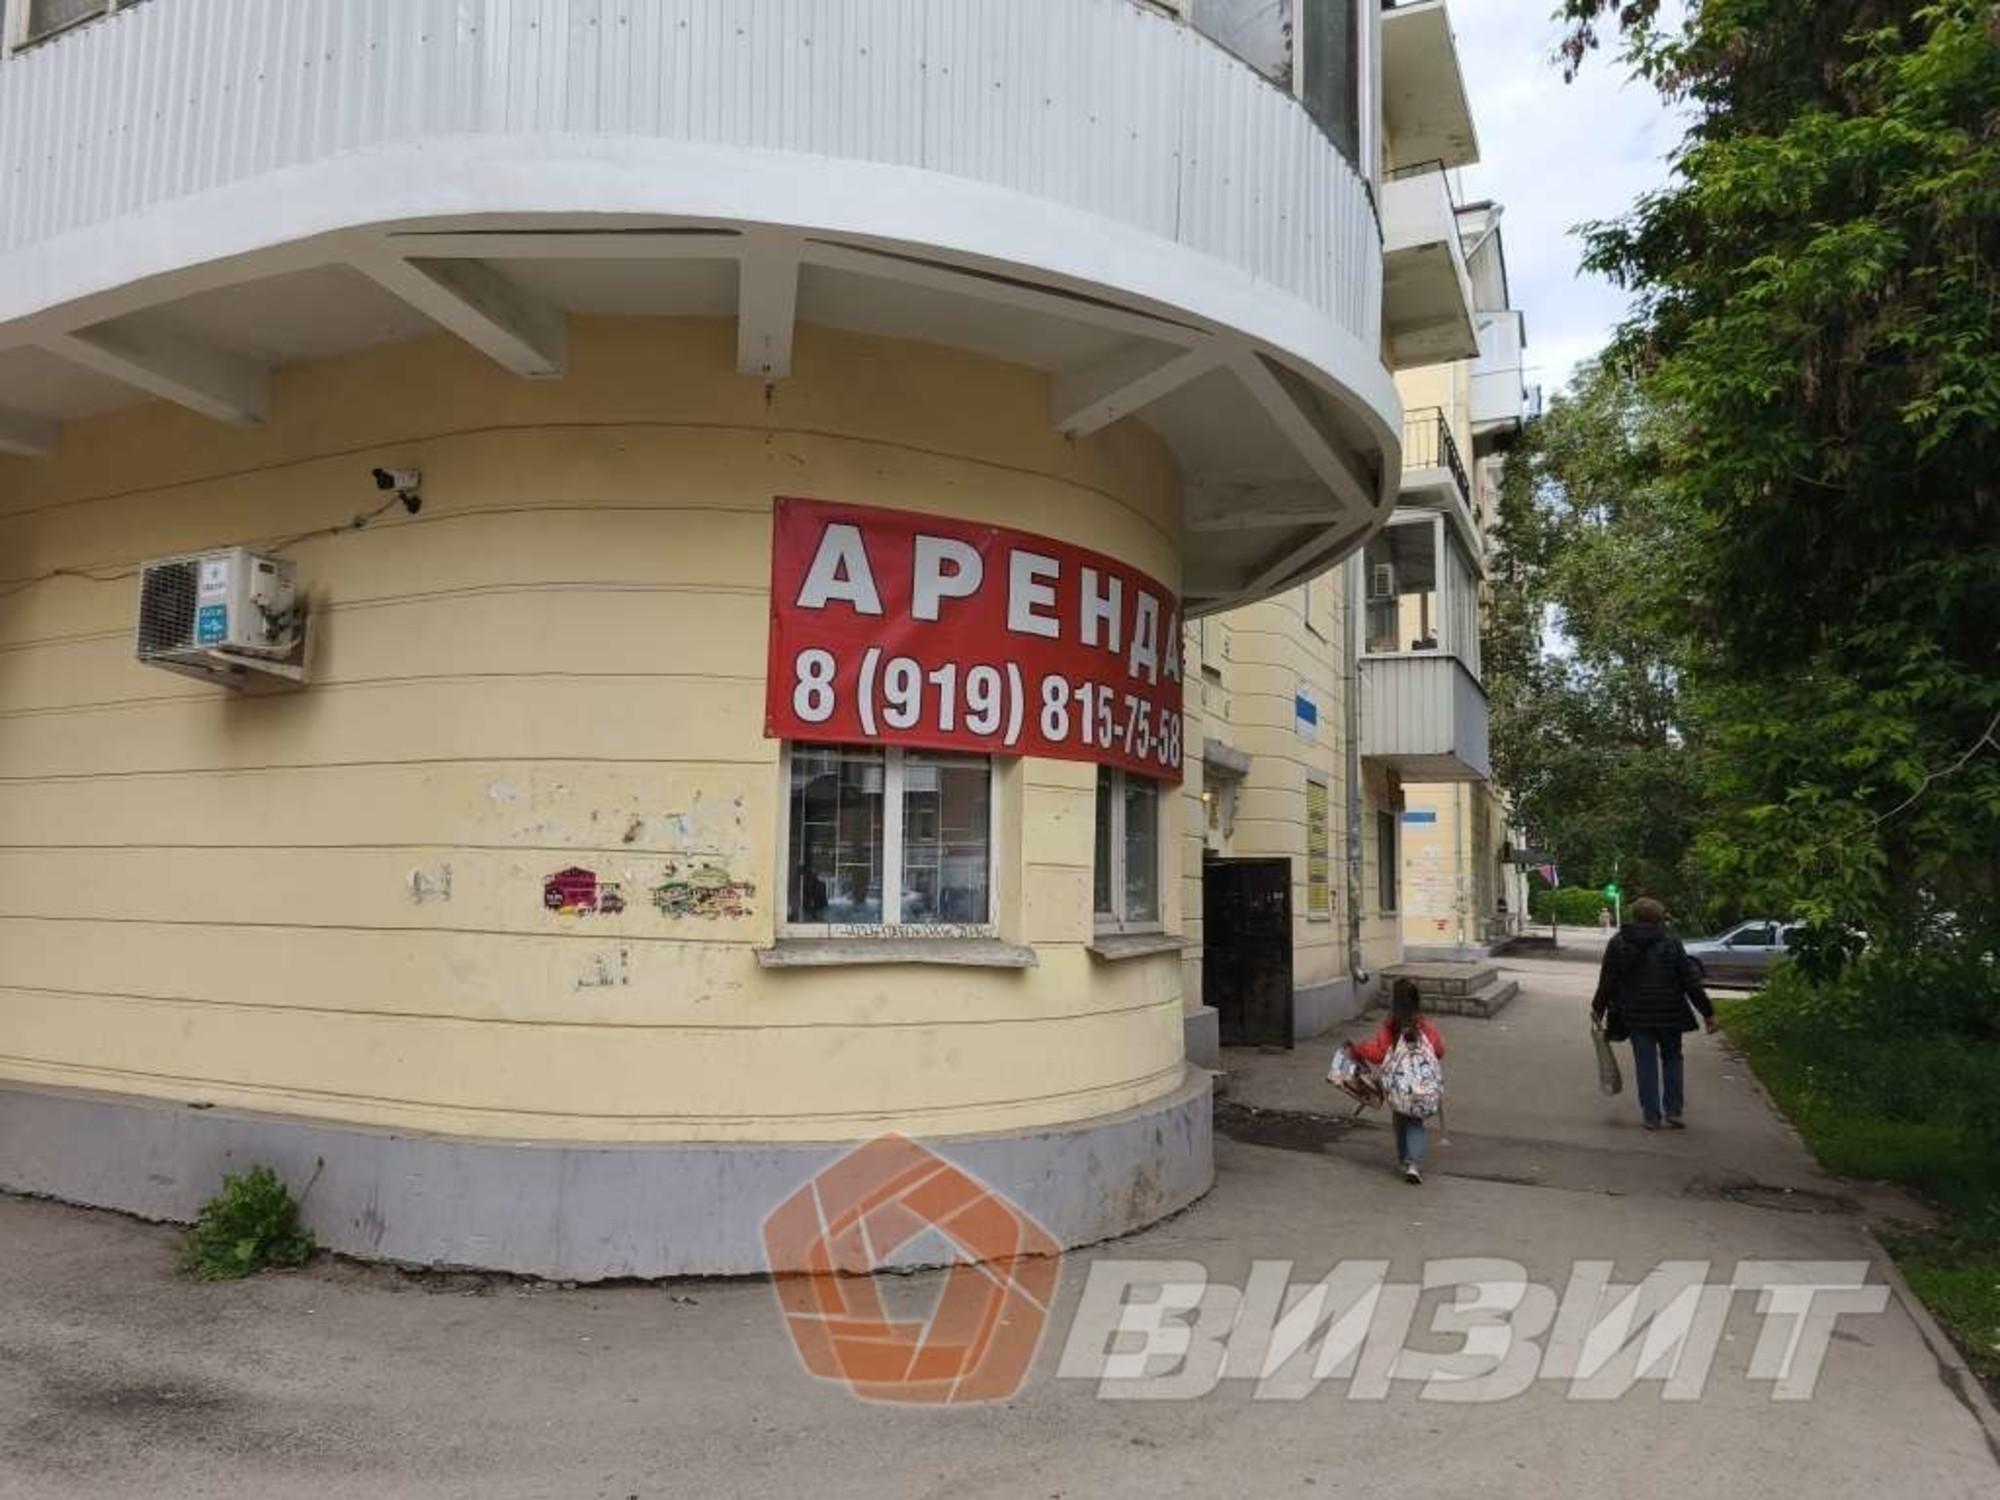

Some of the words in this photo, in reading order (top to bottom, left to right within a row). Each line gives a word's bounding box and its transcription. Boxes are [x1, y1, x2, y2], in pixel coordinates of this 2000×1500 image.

[796, 521, 1181, 685] АРЕНДА
[792, 647, 836, 723] 8
[856, 646, 1026, 747] (919)
[1040, 673, 1182, 769] 815-75-58
